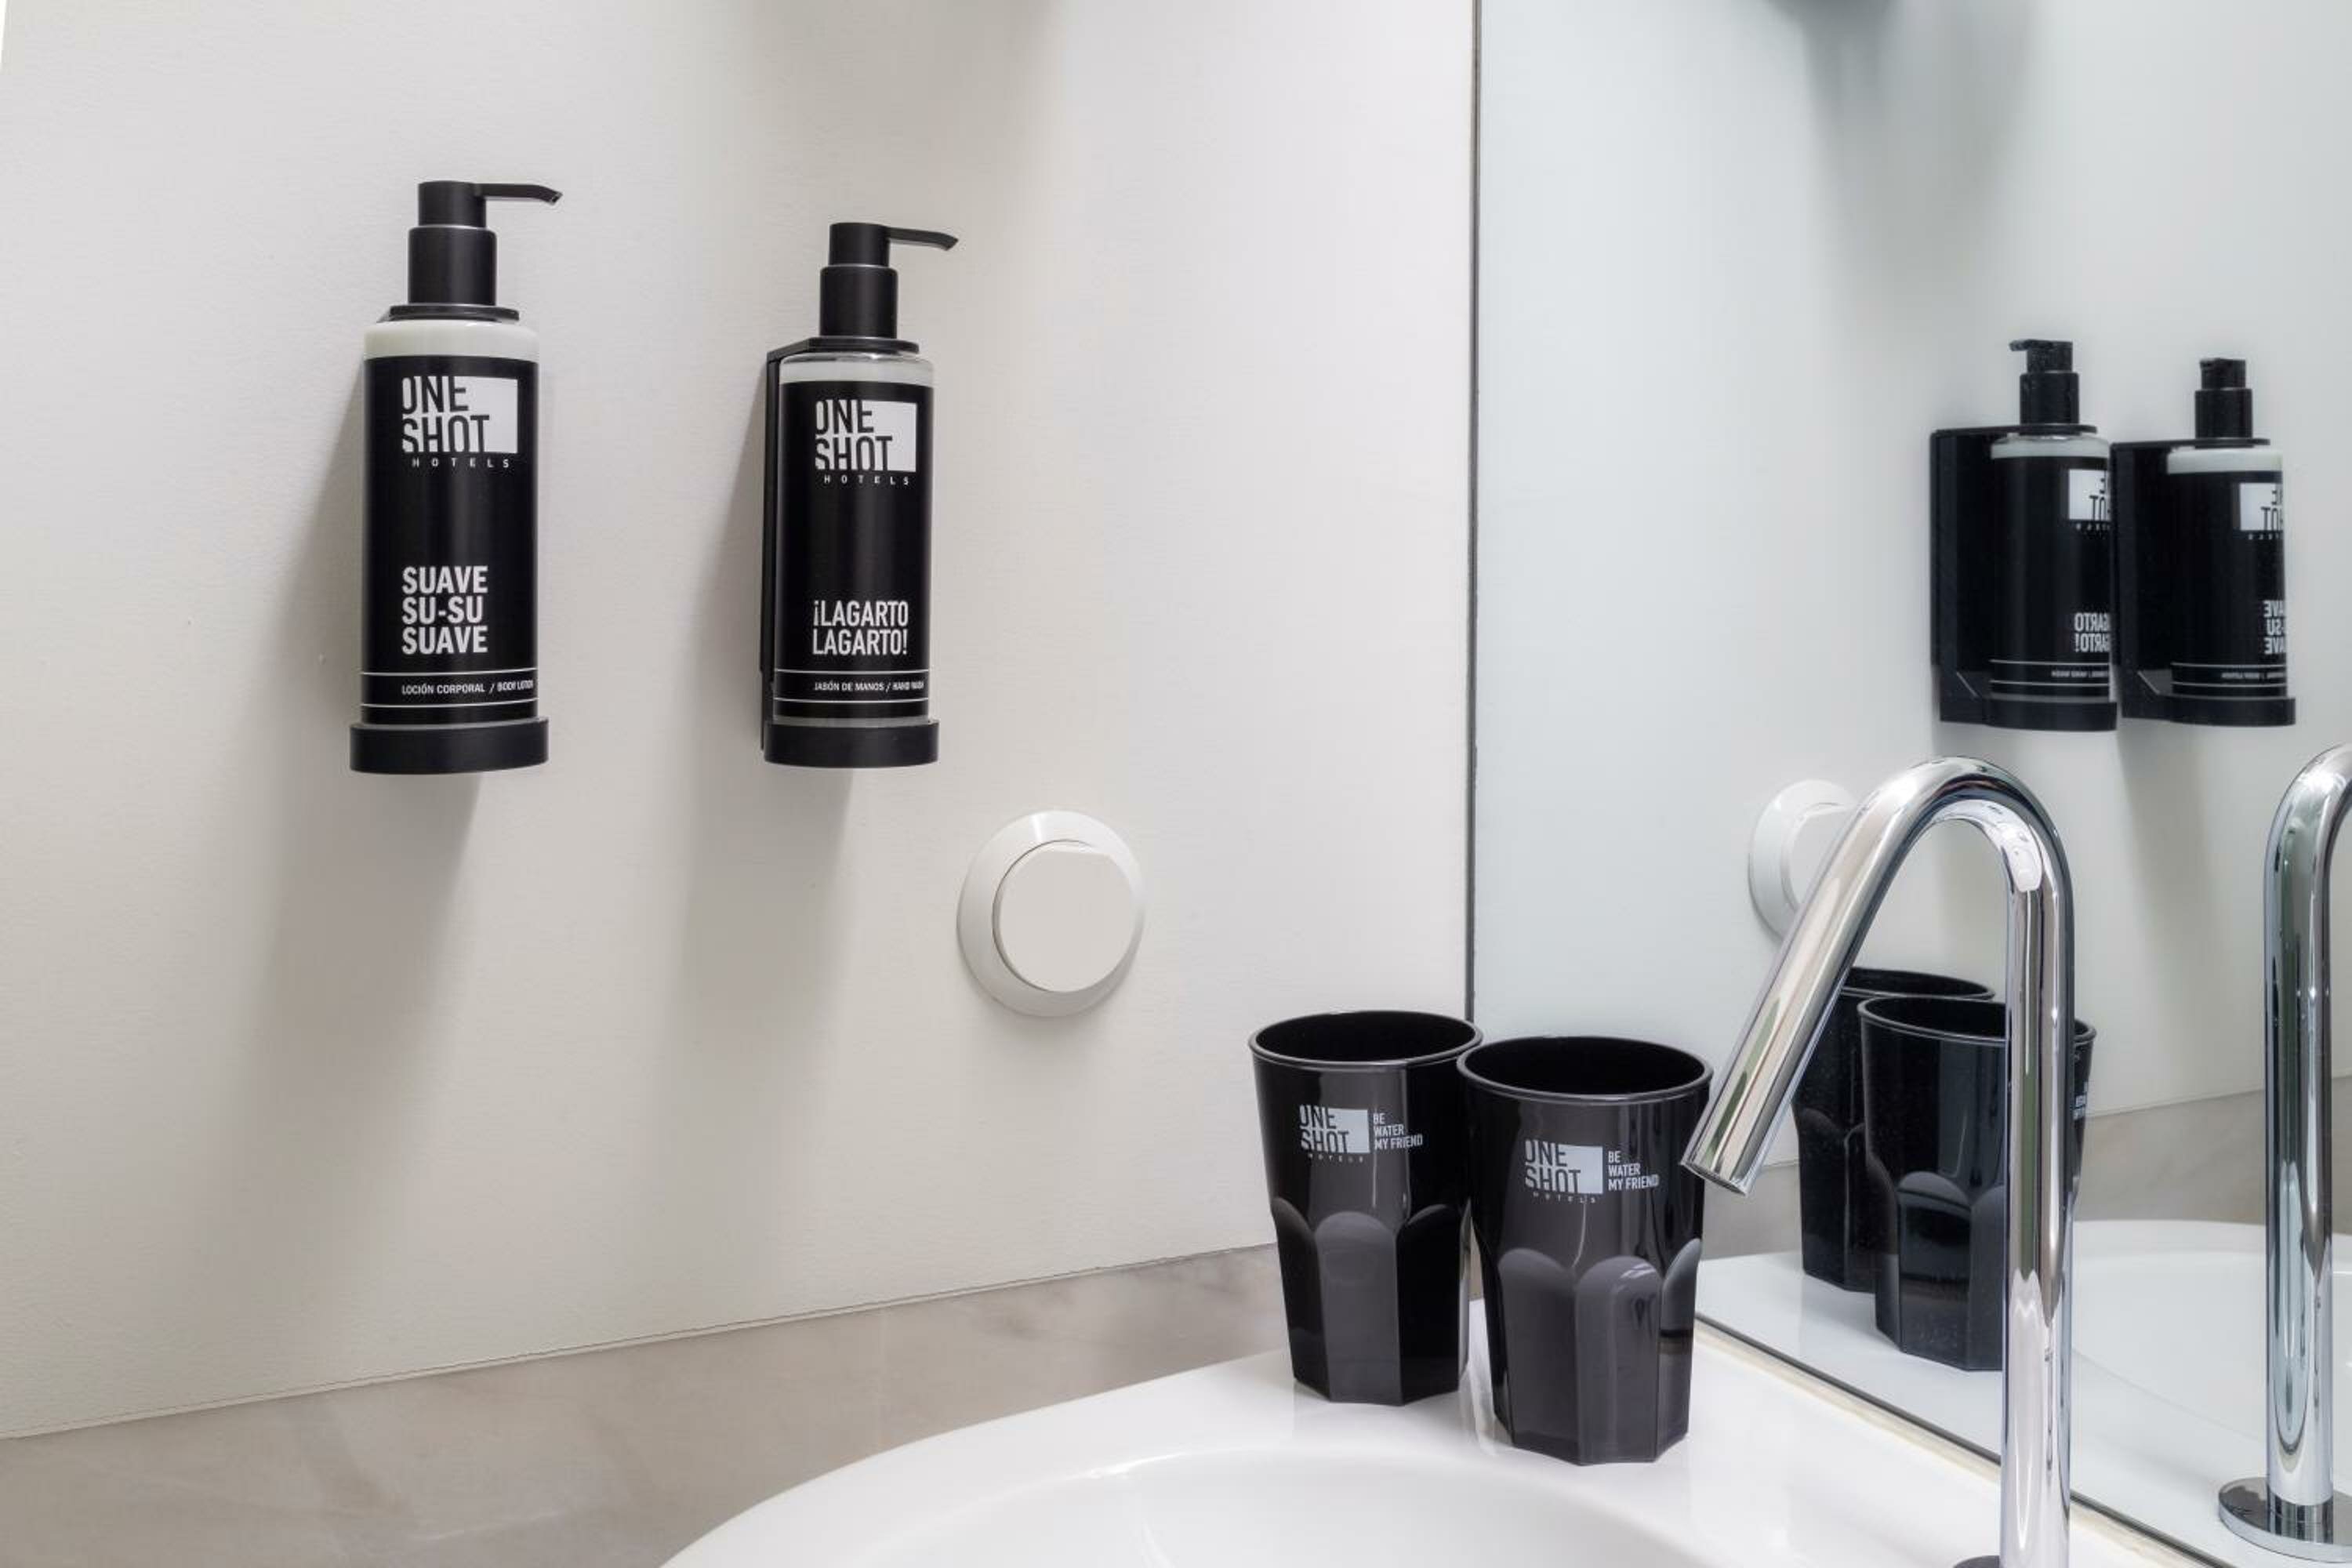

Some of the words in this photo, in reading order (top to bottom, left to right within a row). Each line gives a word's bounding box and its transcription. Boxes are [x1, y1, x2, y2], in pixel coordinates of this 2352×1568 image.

[402, 376, 469, 415] ONE
[815, 399, 874, 434] ONE
[402, 415, 490, 453] SHOT
[412, 457, 510, 468] HOTELS
[815, 435, 893, 471] SHOT
[823, 474, 909, 485] HOTELS
[401, 565, 488, 594] SUAVE
[401, 596, 484, 625] SU-SU
[813, 600, 909, 626] ¡LAGARTO
[401, 626, 488, 655] SUAVE
[812, 629, 908, 655] LAGARTO!
[401, 683, 434, 695] LOCIÓN
[437, 683, 485, 694] CORPORAL
[815, 680, 840, 691] JABÓN
[841, 681, 854, 691] DE
[855, 681, 884, 691] MANOS
[1299, 1105, 1337, 1129] ONE
[1373, 1112, 1385, 1125] BE
[1300, 1130, 1349, 1153] SHOT
[1374, 1124, 1405, 1137] WATER
[1374, 1138, 1388, 1150] MY
[1391, 1134, 1424, 1149] FRIEND
[1525, 1139, 1568, 1167] ONE
[1608, 1150, 1621, 1163] BE
[1525, 1167, 1581, 1193] SHOT
[1608, 1163, 1641, 1177] WATER
[1608, 1178, 1624, 1191] MY
[1626, 1174, 1660, 1190] FRIEND
